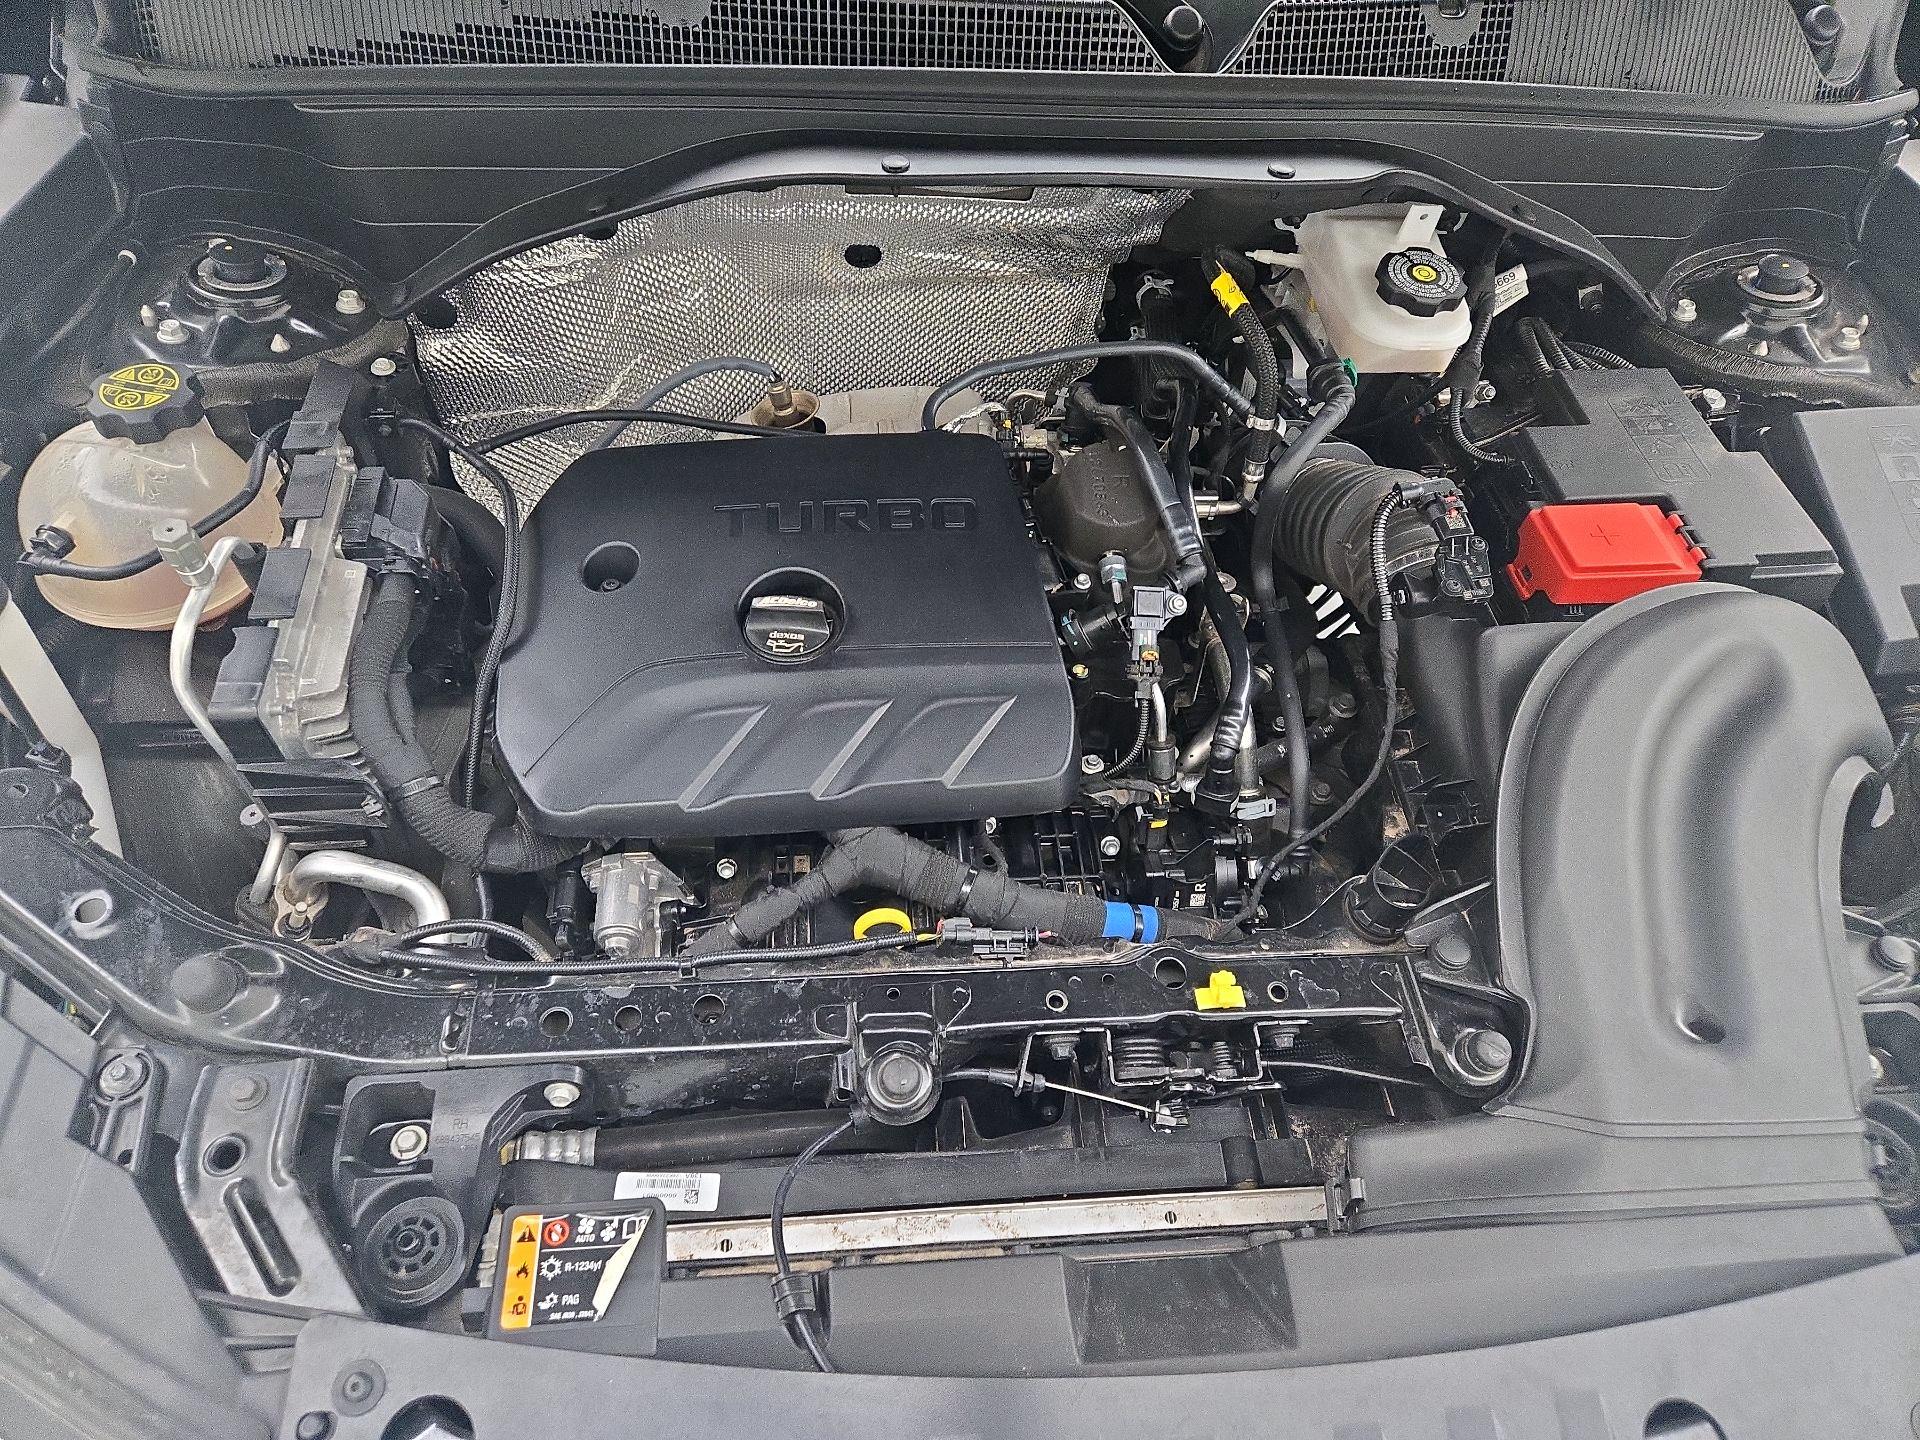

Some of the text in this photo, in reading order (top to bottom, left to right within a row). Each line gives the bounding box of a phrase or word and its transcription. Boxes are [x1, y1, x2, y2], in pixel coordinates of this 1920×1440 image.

[713, 498, 977, 536] TURBO
[575, 1234, 596, 1243] AUTO
[561, 1294, 580, 1306] PAG
